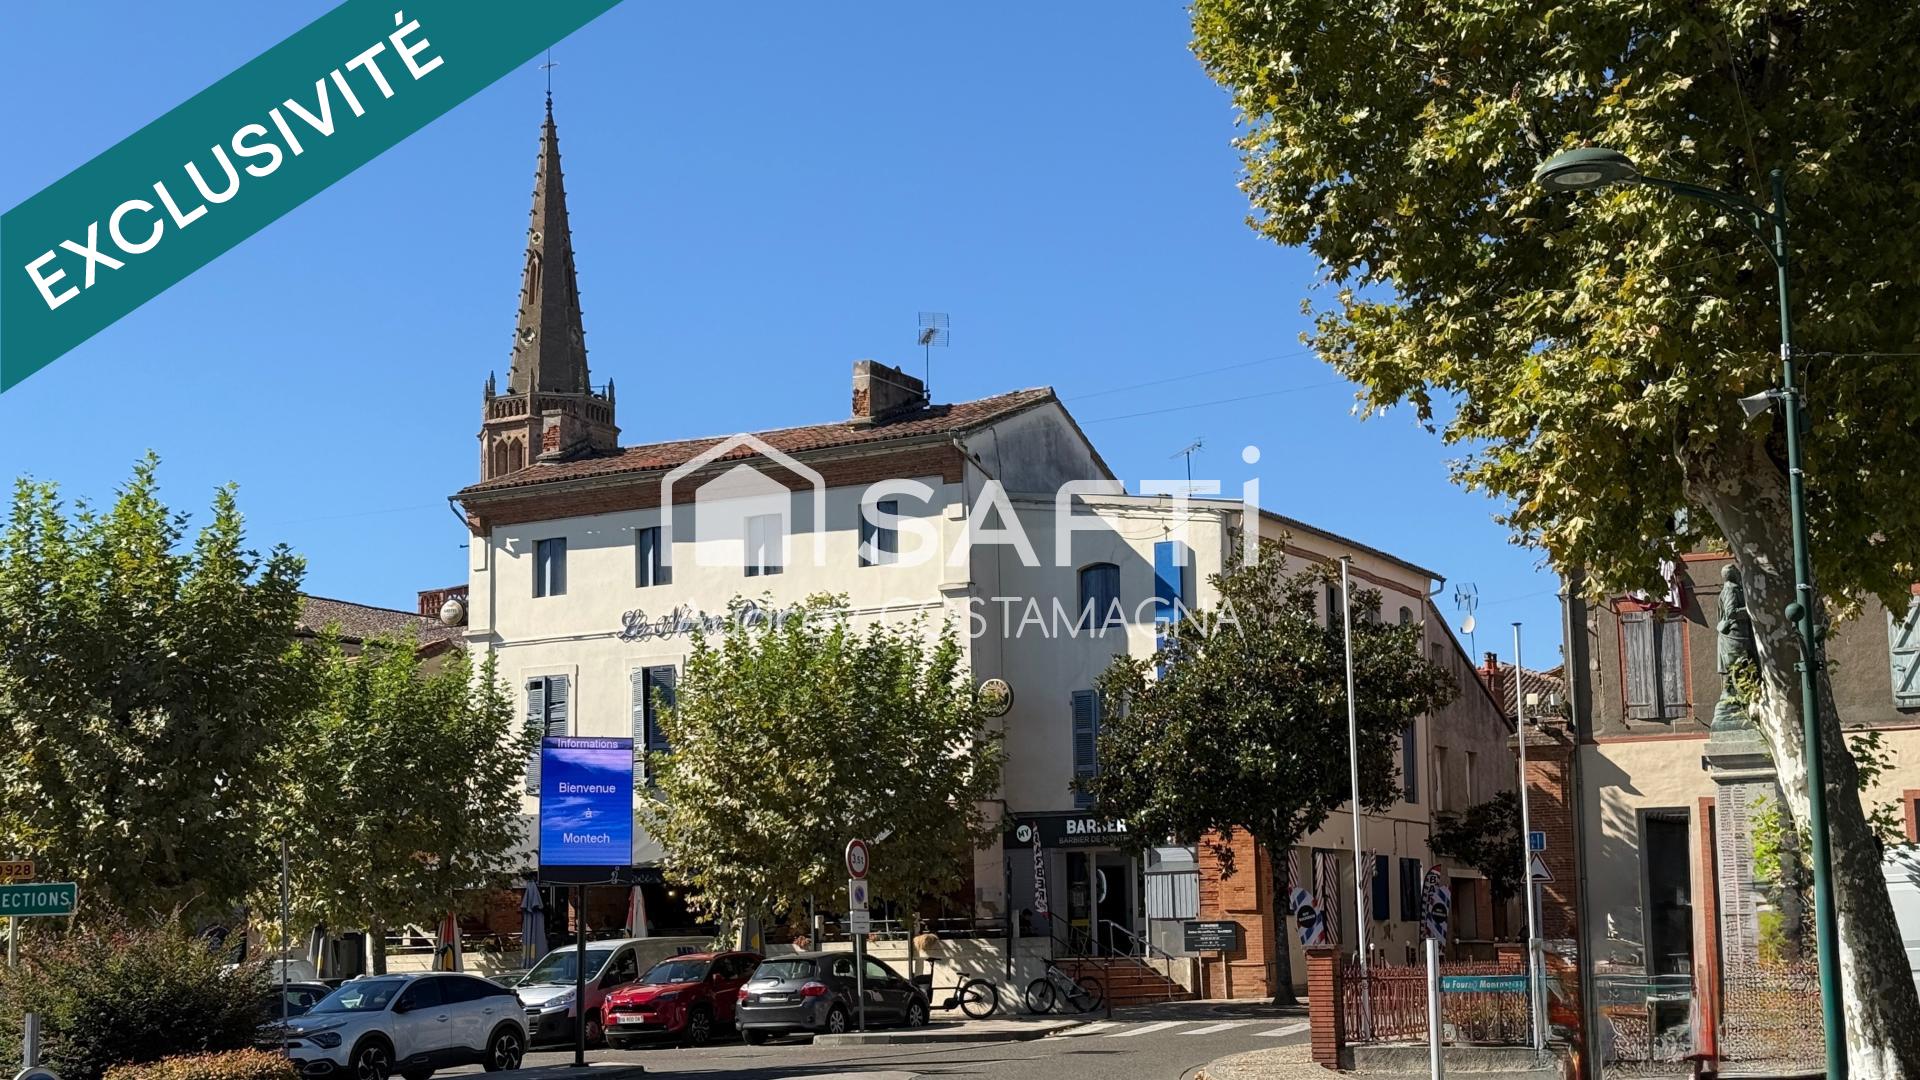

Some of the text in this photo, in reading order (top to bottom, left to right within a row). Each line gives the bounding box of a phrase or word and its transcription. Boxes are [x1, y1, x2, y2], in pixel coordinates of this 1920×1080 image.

[558, 739, 618, 748] Informations
[559, 782, 616, 794] Bienvenue
[585, 808, 593, 818] à
[563, 833, 611, 844] Montech
[2, 891, 69, 908] ECTIONS
